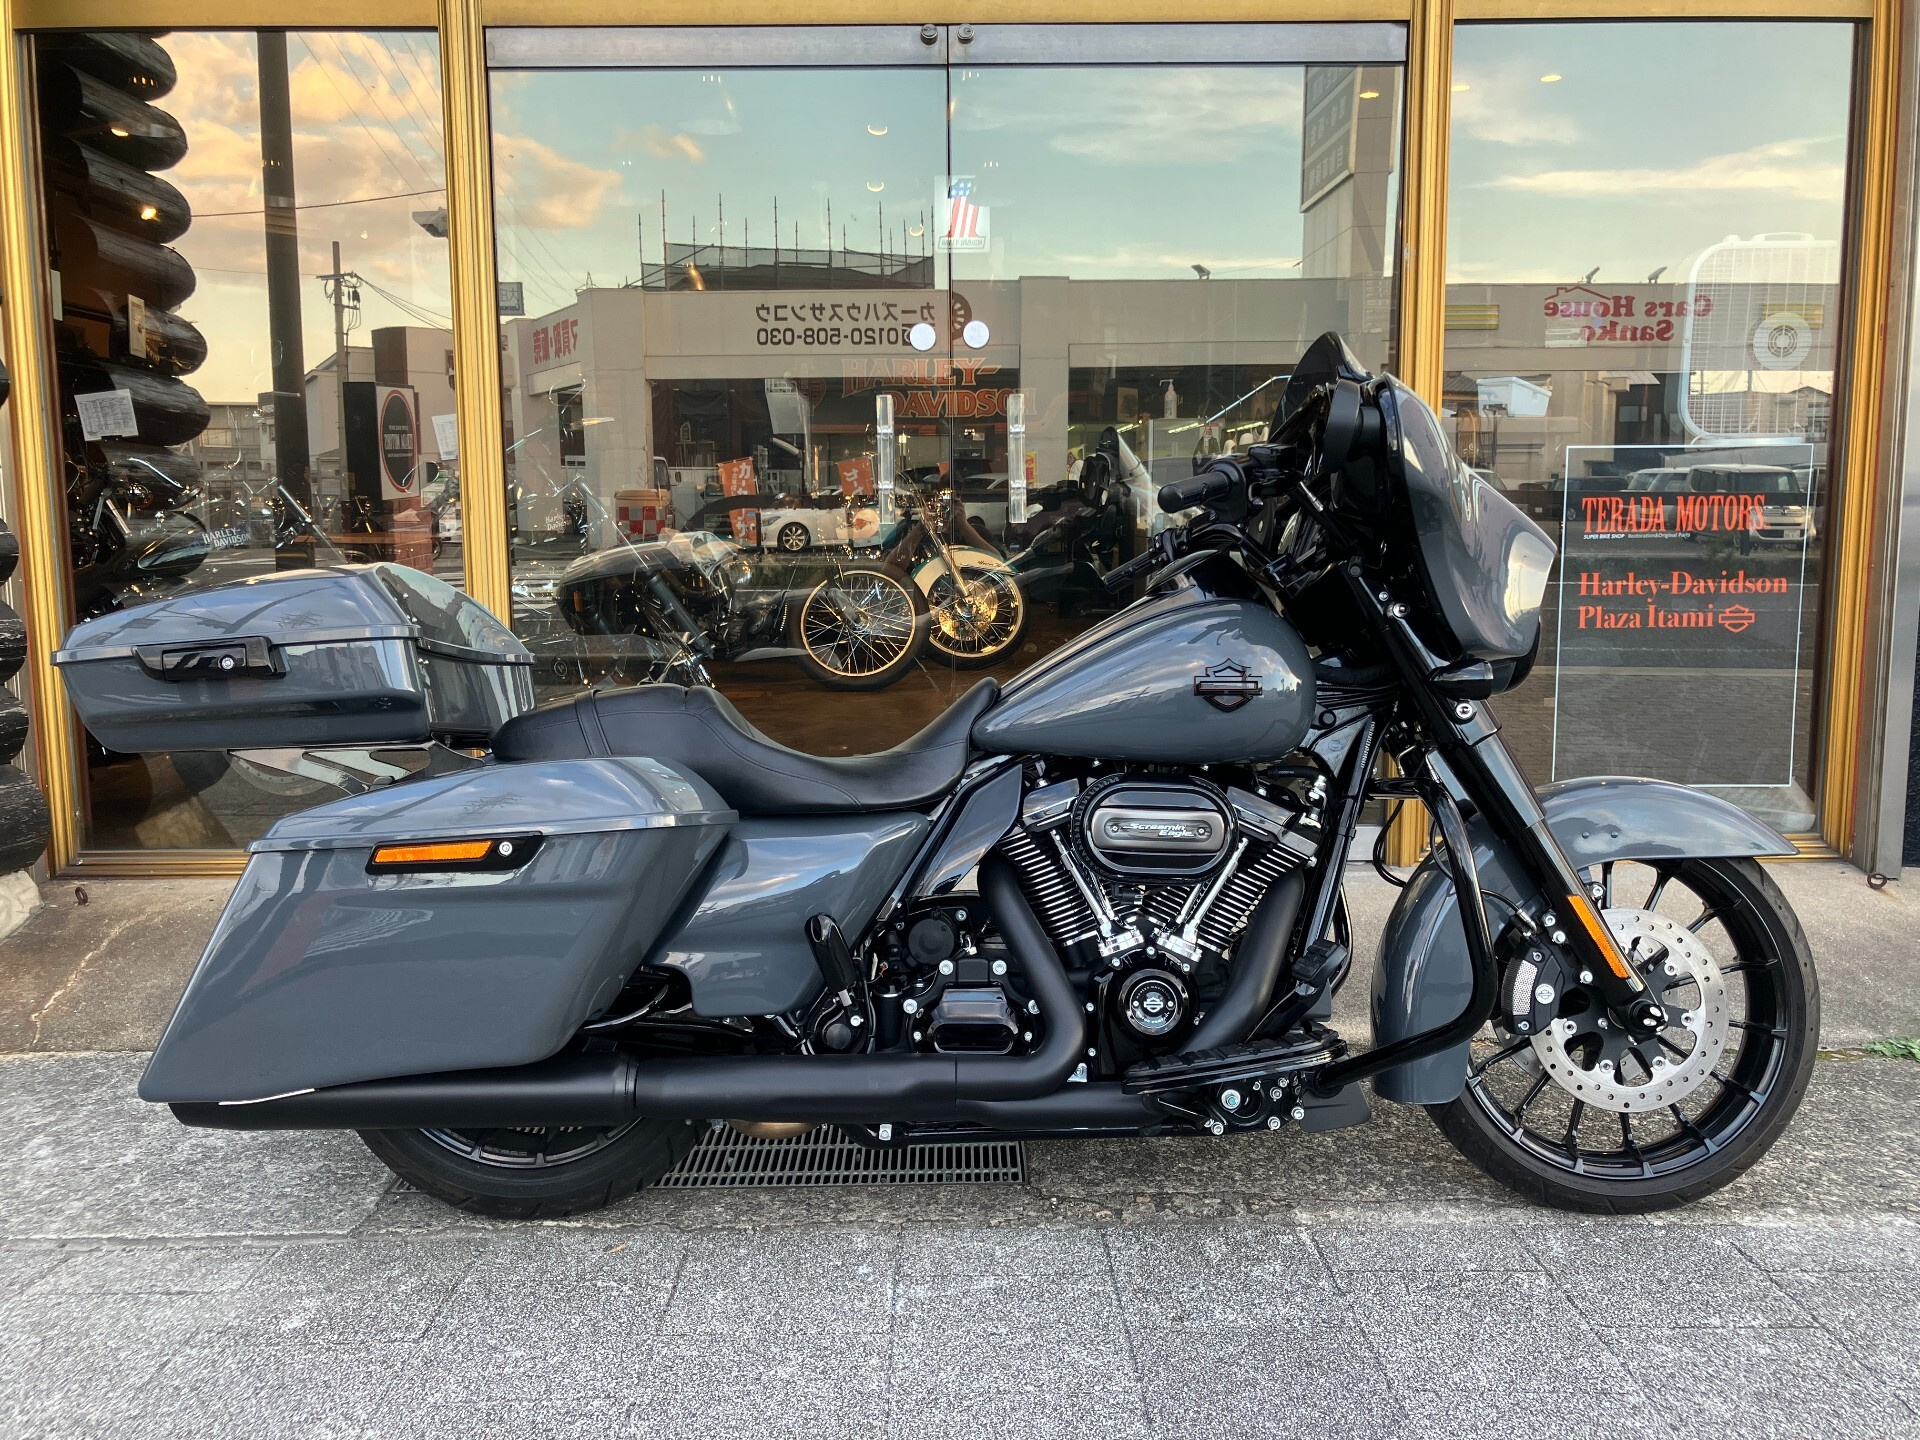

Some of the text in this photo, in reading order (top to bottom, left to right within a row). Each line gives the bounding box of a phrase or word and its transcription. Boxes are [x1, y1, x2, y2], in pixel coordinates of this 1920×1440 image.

[841, 357, 1003, 399] HARLEY-
[882, 387, 1038, 418] DAVIDSON
[1581, 494, 1766, 534] TERADA MOTORS
[213, 533, 252, 548] DAVIDSON
[1578, 570, 1788, 603] Harley-Davidson
[1577, 603, 1714, 629] Plaza Itami
[1158, 829, 1195, 838] Eagle
